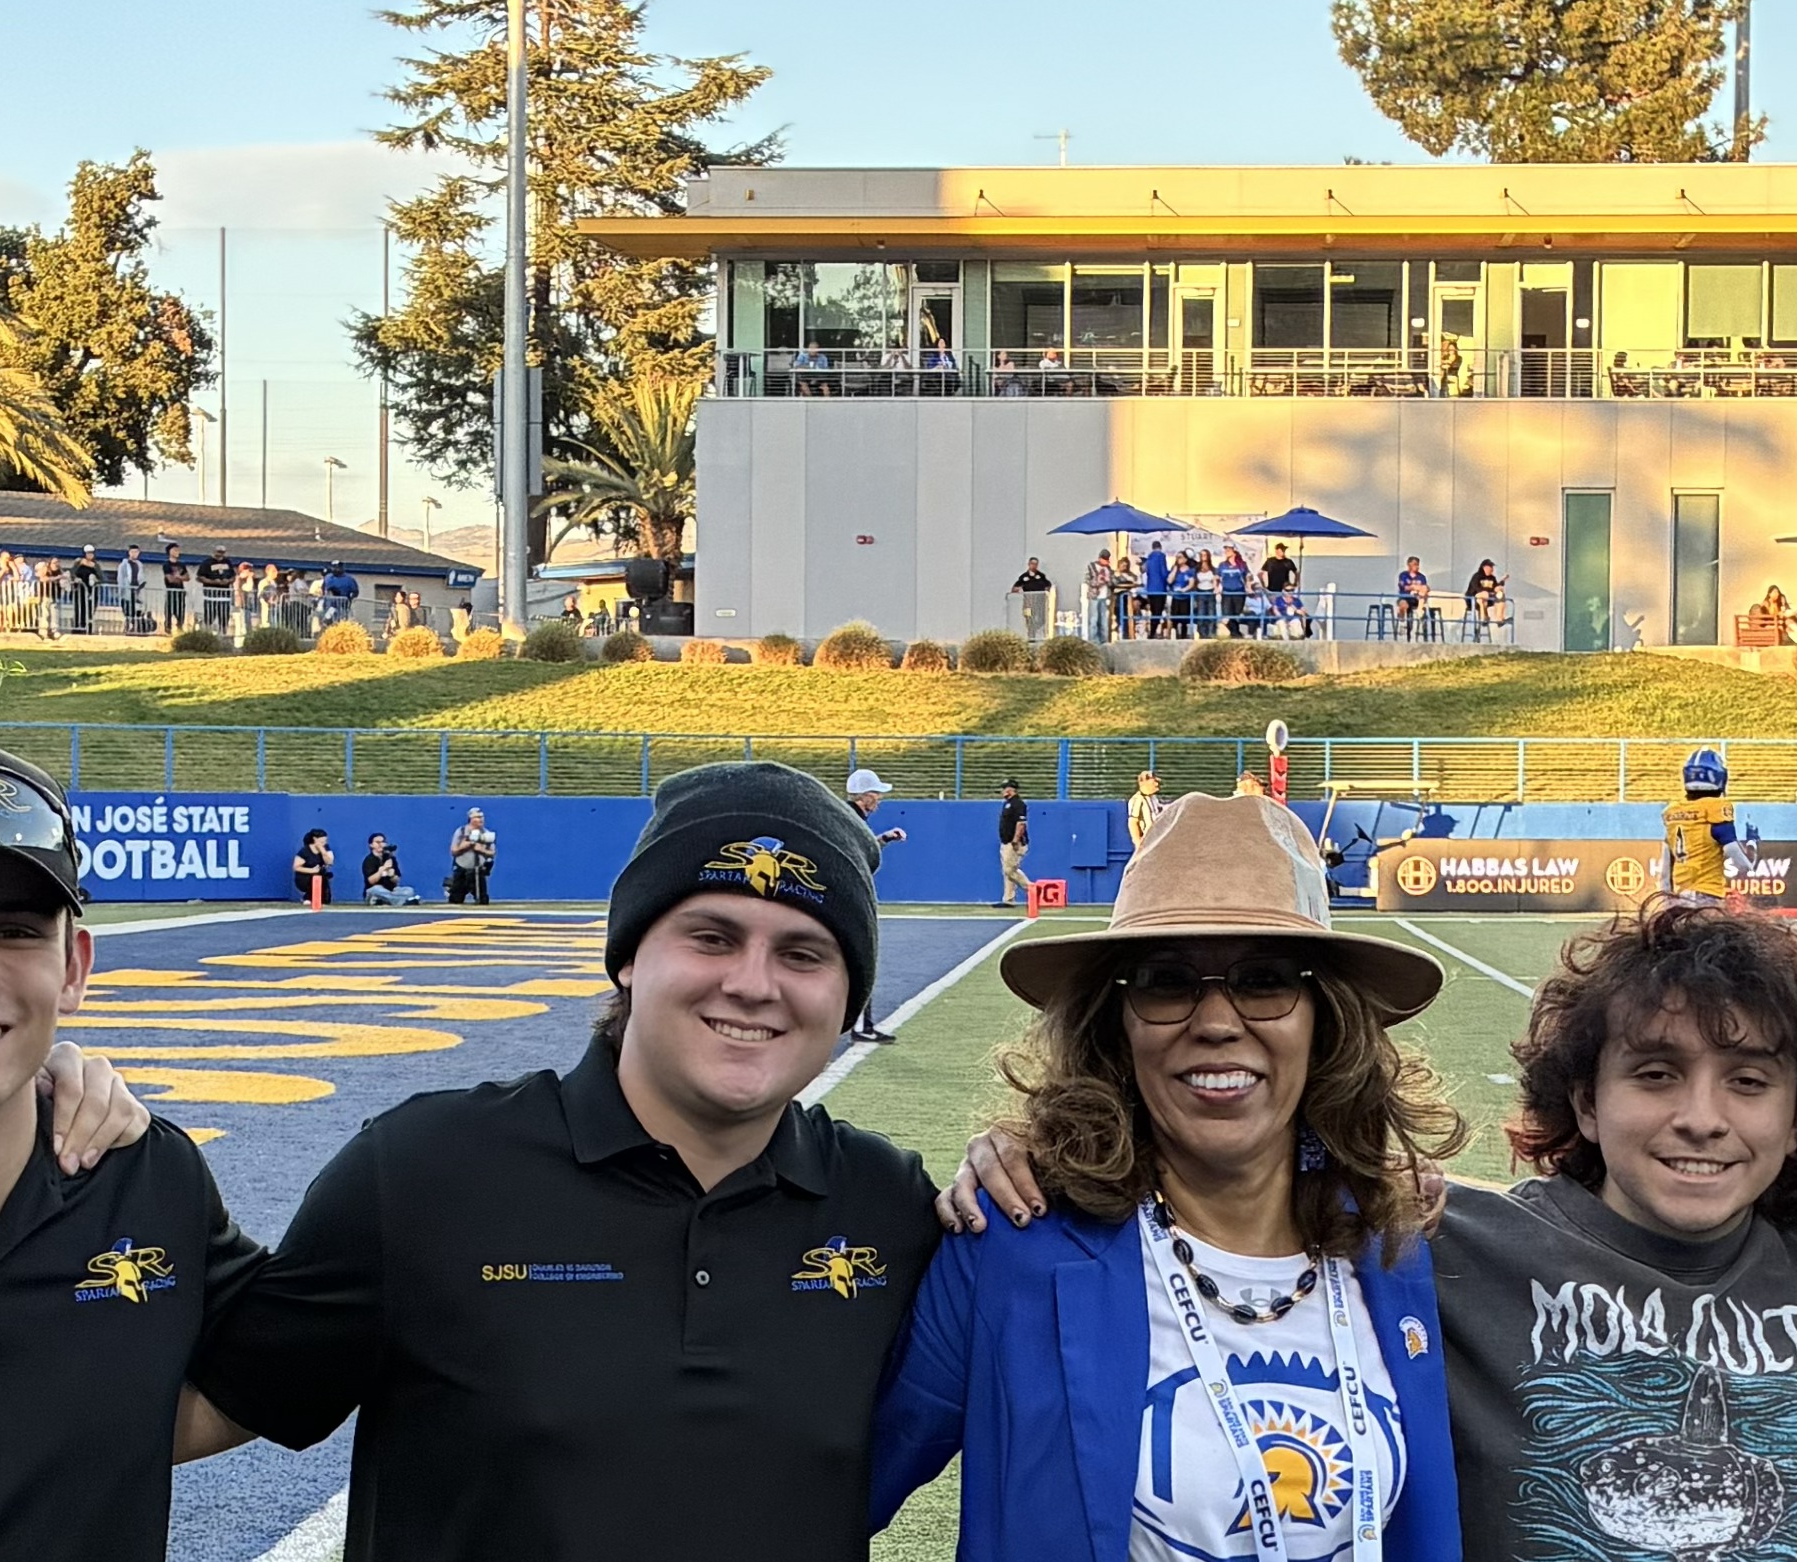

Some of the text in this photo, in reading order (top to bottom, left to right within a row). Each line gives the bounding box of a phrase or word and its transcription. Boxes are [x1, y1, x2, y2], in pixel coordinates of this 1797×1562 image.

[96, 797, 168, 834] JOSÉ
[172, 806, 250, 834] STATE
[1042, 883, 1059, 903] G
[1439, 857, 1579, 877] HABBAS LAW
[481, 1264, 527, 1281] SJSU
[1169, 1272, 1207, 1343] CEFCU
[1530, 1278, 1669, 1366] MOLA
[1343, 1366, 1367, 1436] CEFCU
[1250, 1479, 1278, 1549] CEFCU
